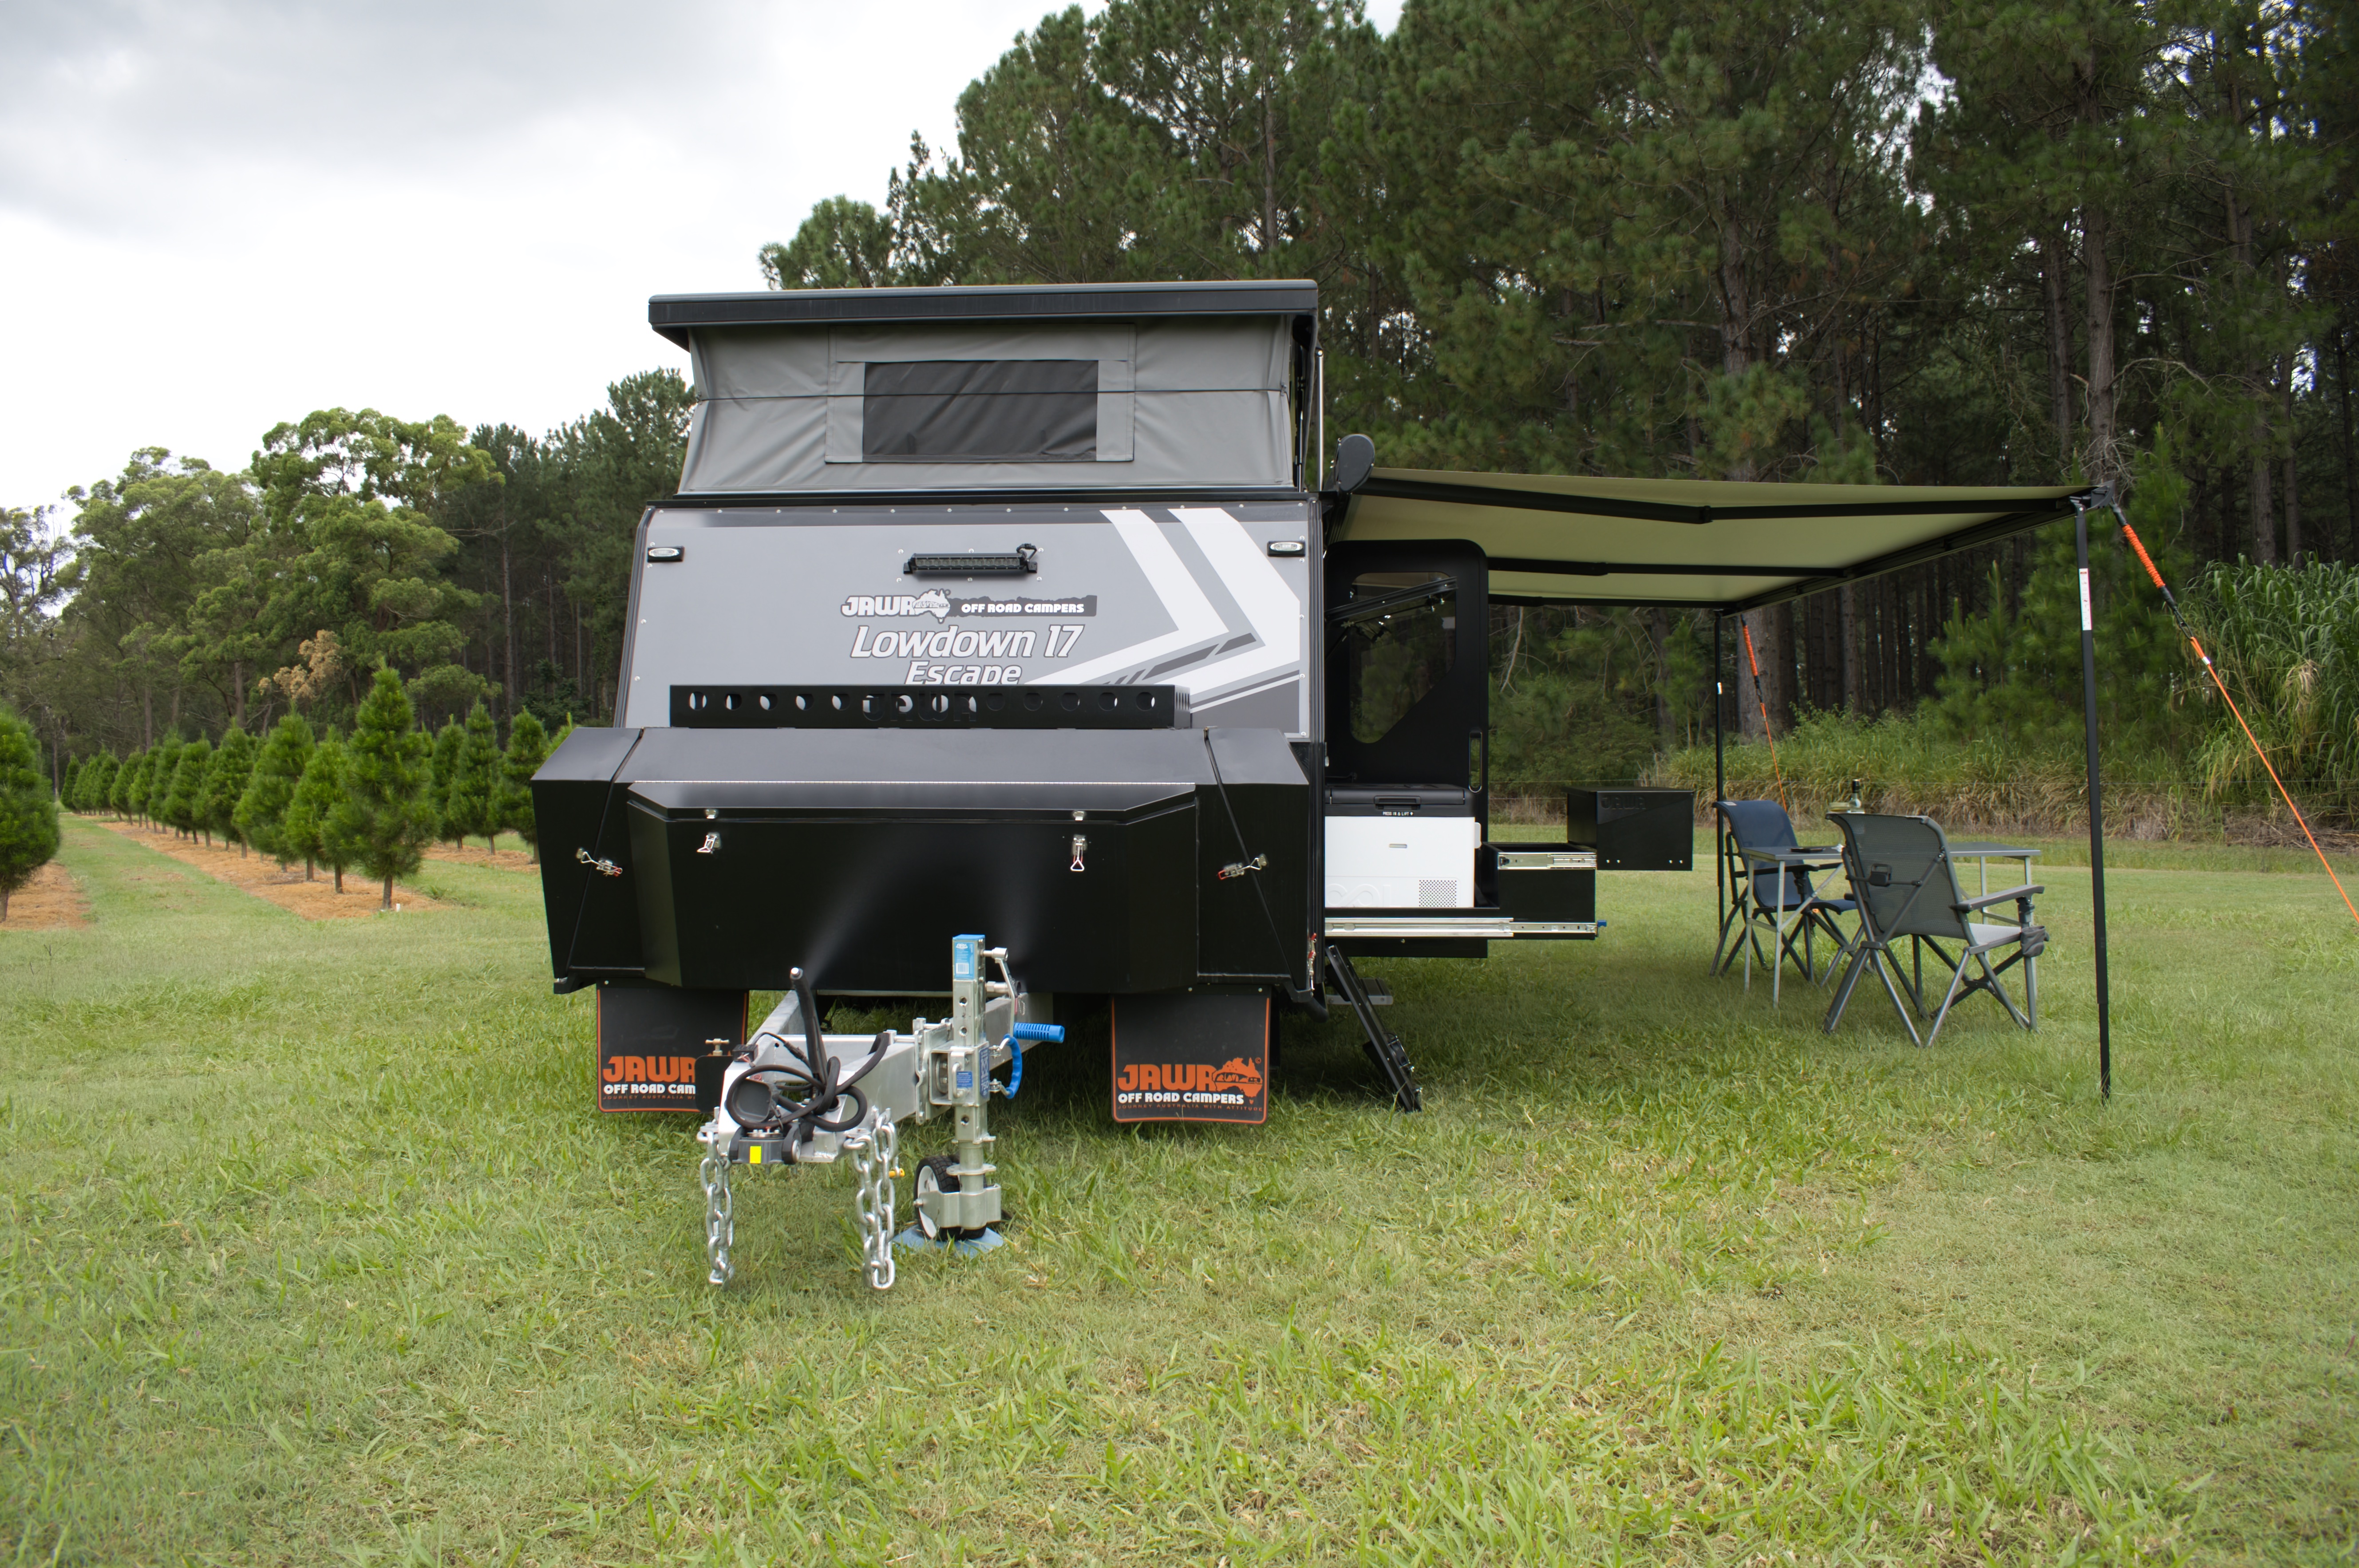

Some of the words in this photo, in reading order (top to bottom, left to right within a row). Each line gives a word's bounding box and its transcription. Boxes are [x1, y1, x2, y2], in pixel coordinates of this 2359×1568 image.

[961, 603, 985, 613] OFF
[988, 603, 1022, 613] ROAD
[1024, 603, 1084, 613] CAMPERS
[850, 625, 1036, 658] Lowdown
[1043, 624, 1085, 658] 17
[1118, 1064, 1217, 1091] JAWA
[604, 1084, 628, 1094] OFF
[631, 1084, 665, 1094] ROAD
[668, 1084, 696, 1094] CAM
[1118, 1093, 1142, 1104] OFF
[1145, 1092, 1180, 1102] ROAD
[1183, 1092, 1244, 1104] CAMPERS
